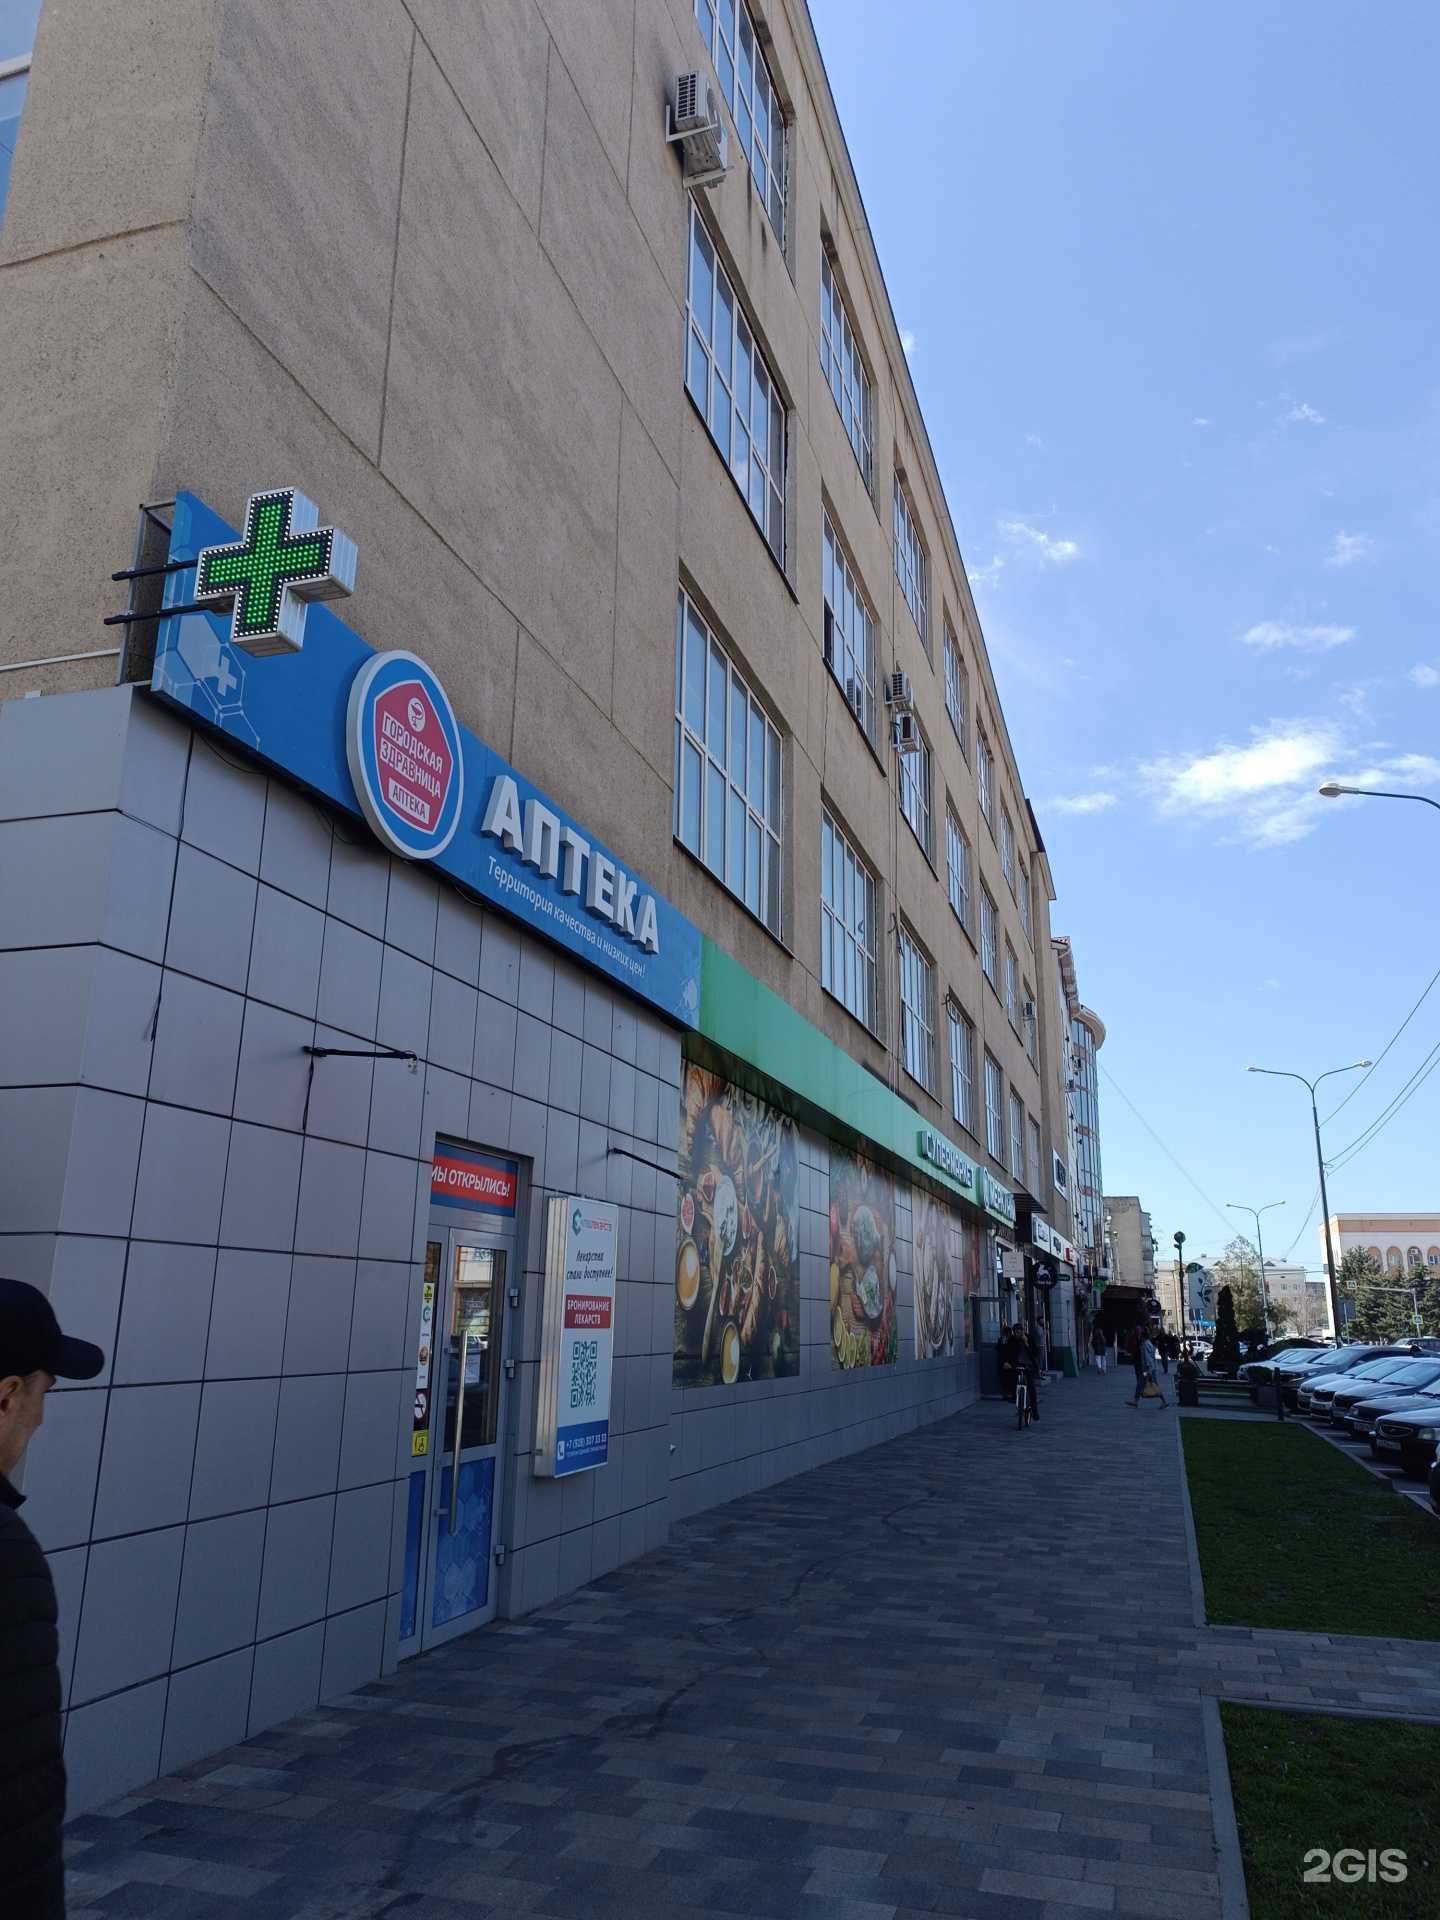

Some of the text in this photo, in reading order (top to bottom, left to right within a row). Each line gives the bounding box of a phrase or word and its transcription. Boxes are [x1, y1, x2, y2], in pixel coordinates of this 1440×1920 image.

[380, 739, 442, 800] ЗДРАВНИЦА
[383, 712, 444, 774] ГОРОДСКАЯ
[392, 784, 427, 820] АПТЕКА
[480, 775, 660, 955] АПТЕКА
[488, 855, 553, 914] Территория
[554, 905, 596, 944] качества
[603, 939, 629, 967] низких
[448, 1169, 511, 1198] ОТКРЫЛИСЬ!
[567, 1299, 610, 1312] БРОНИРОВАНИЕ
